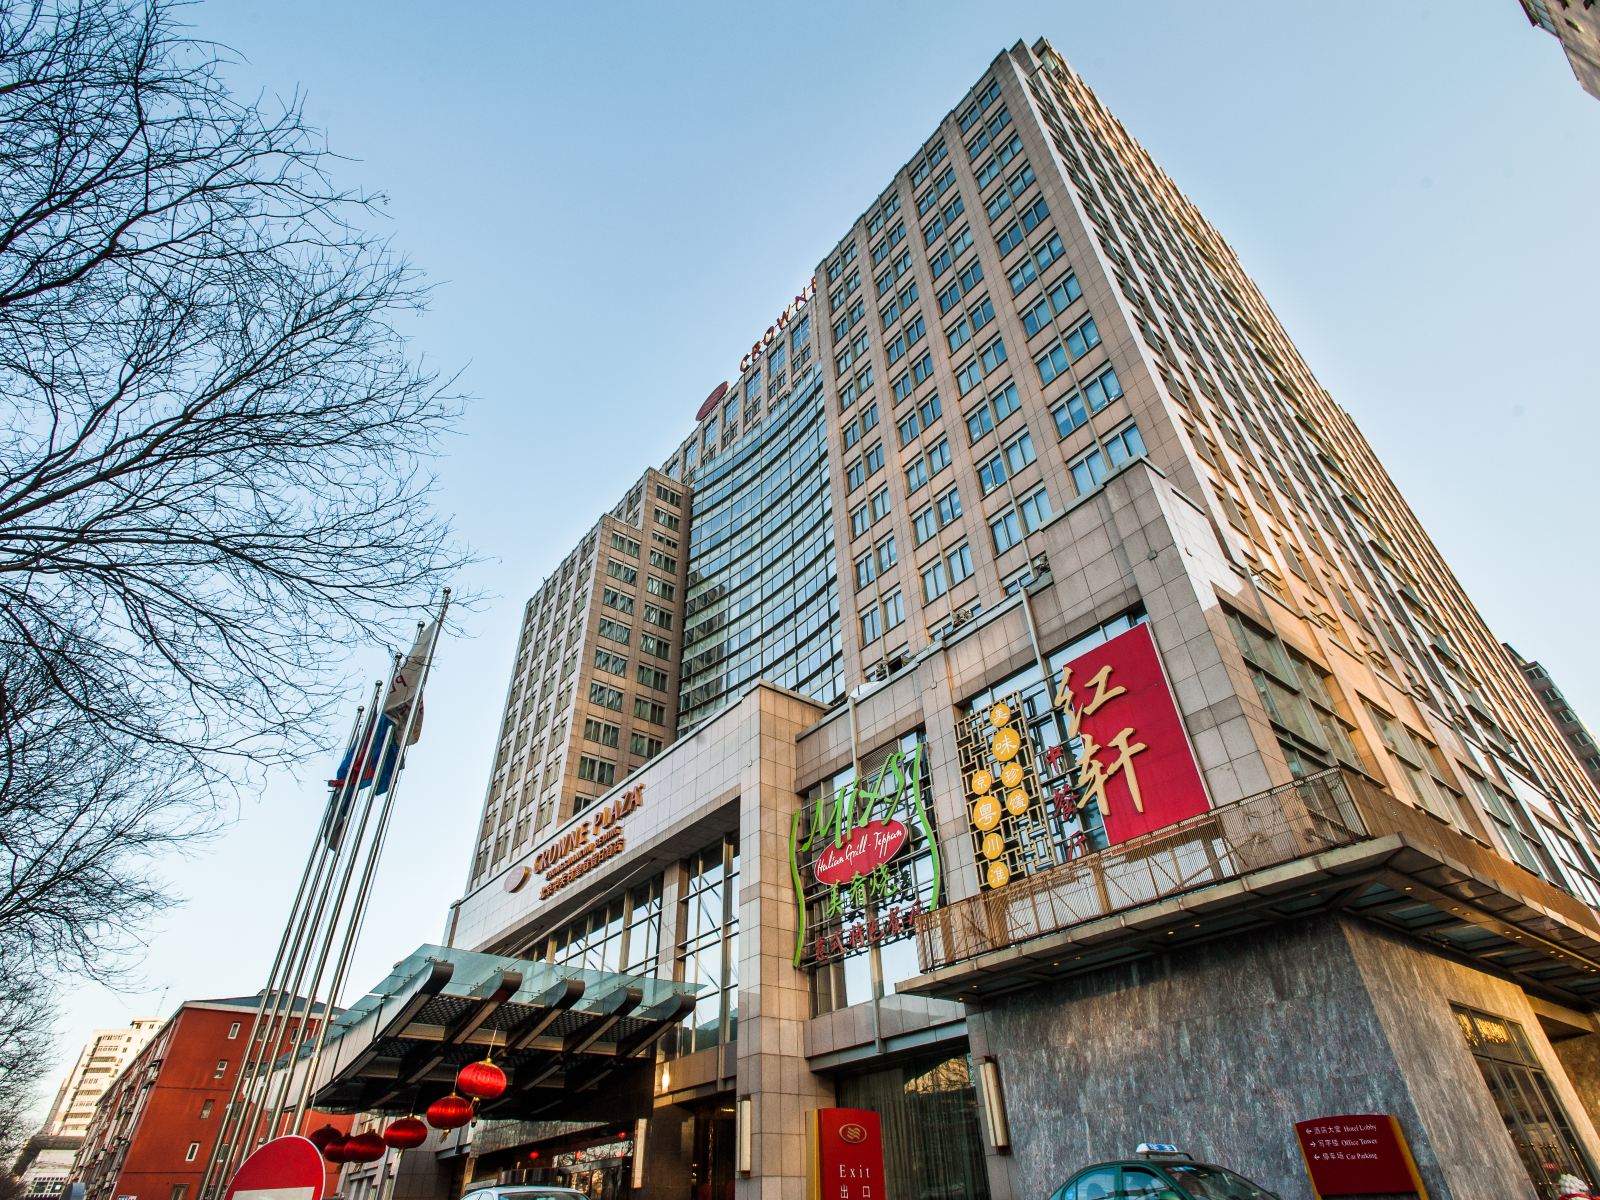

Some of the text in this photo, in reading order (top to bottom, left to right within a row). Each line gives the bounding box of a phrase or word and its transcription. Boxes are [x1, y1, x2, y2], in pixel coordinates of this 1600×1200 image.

[1055, 665, 1148, 816] 红轩
[534, 783, 645, 874] CROWNE PLAZA
[817, 850, 844, 876] Italian
[845, 833, 868, 866] Grill
[873, 829, 902, 858] Teppan
[1343, 1124, 1359, 1132] Hotel
[1359, 1123, 1377, 1132] Lobby
[1357, 1152, 1378, 1160] Parking
[839, 1164, 870, 1178] Exit
[840, 1184, 871, 1199] 出口
